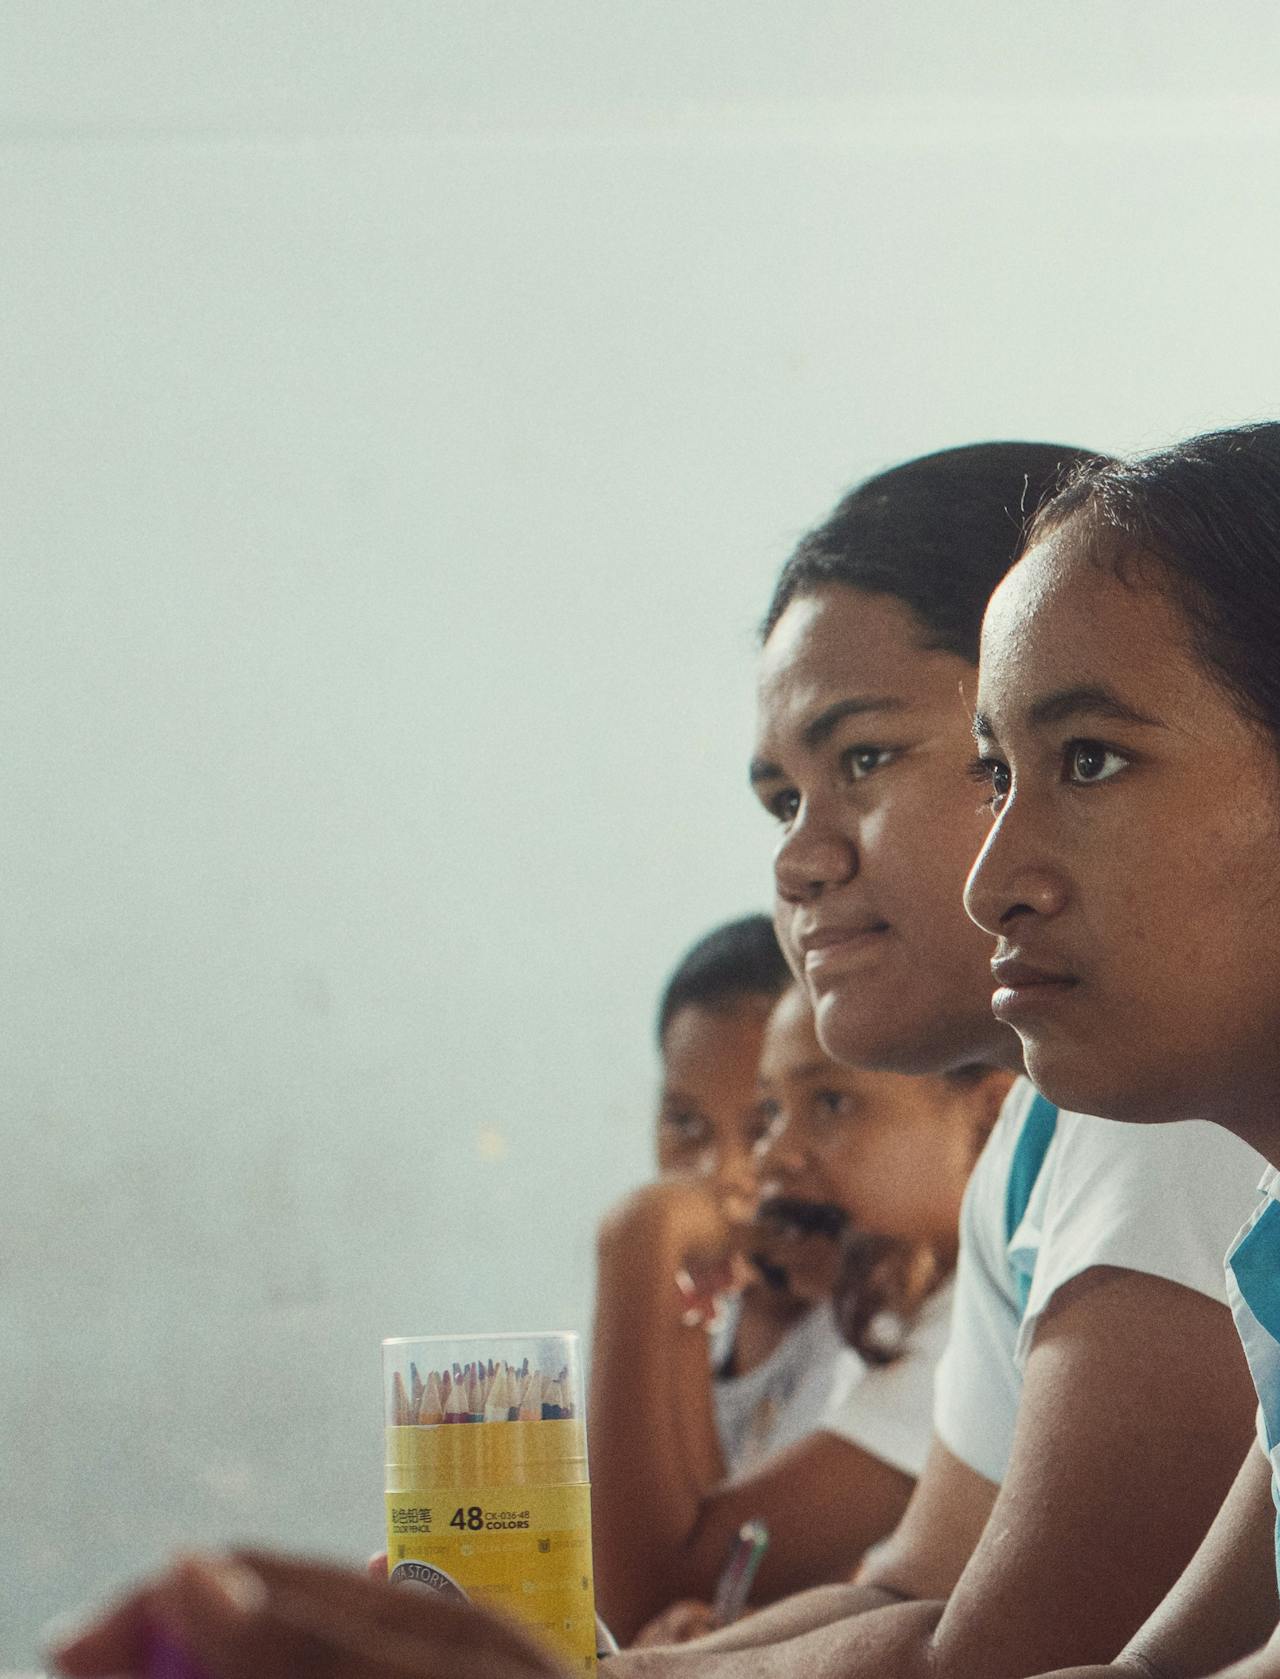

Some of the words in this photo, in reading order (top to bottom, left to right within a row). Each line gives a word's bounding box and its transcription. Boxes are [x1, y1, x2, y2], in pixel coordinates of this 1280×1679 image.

[450, 1506, 484, 1531] 48
[486, 1520, 530, 1530] COLORS
[408, 1565, 449, 1590] STORY
